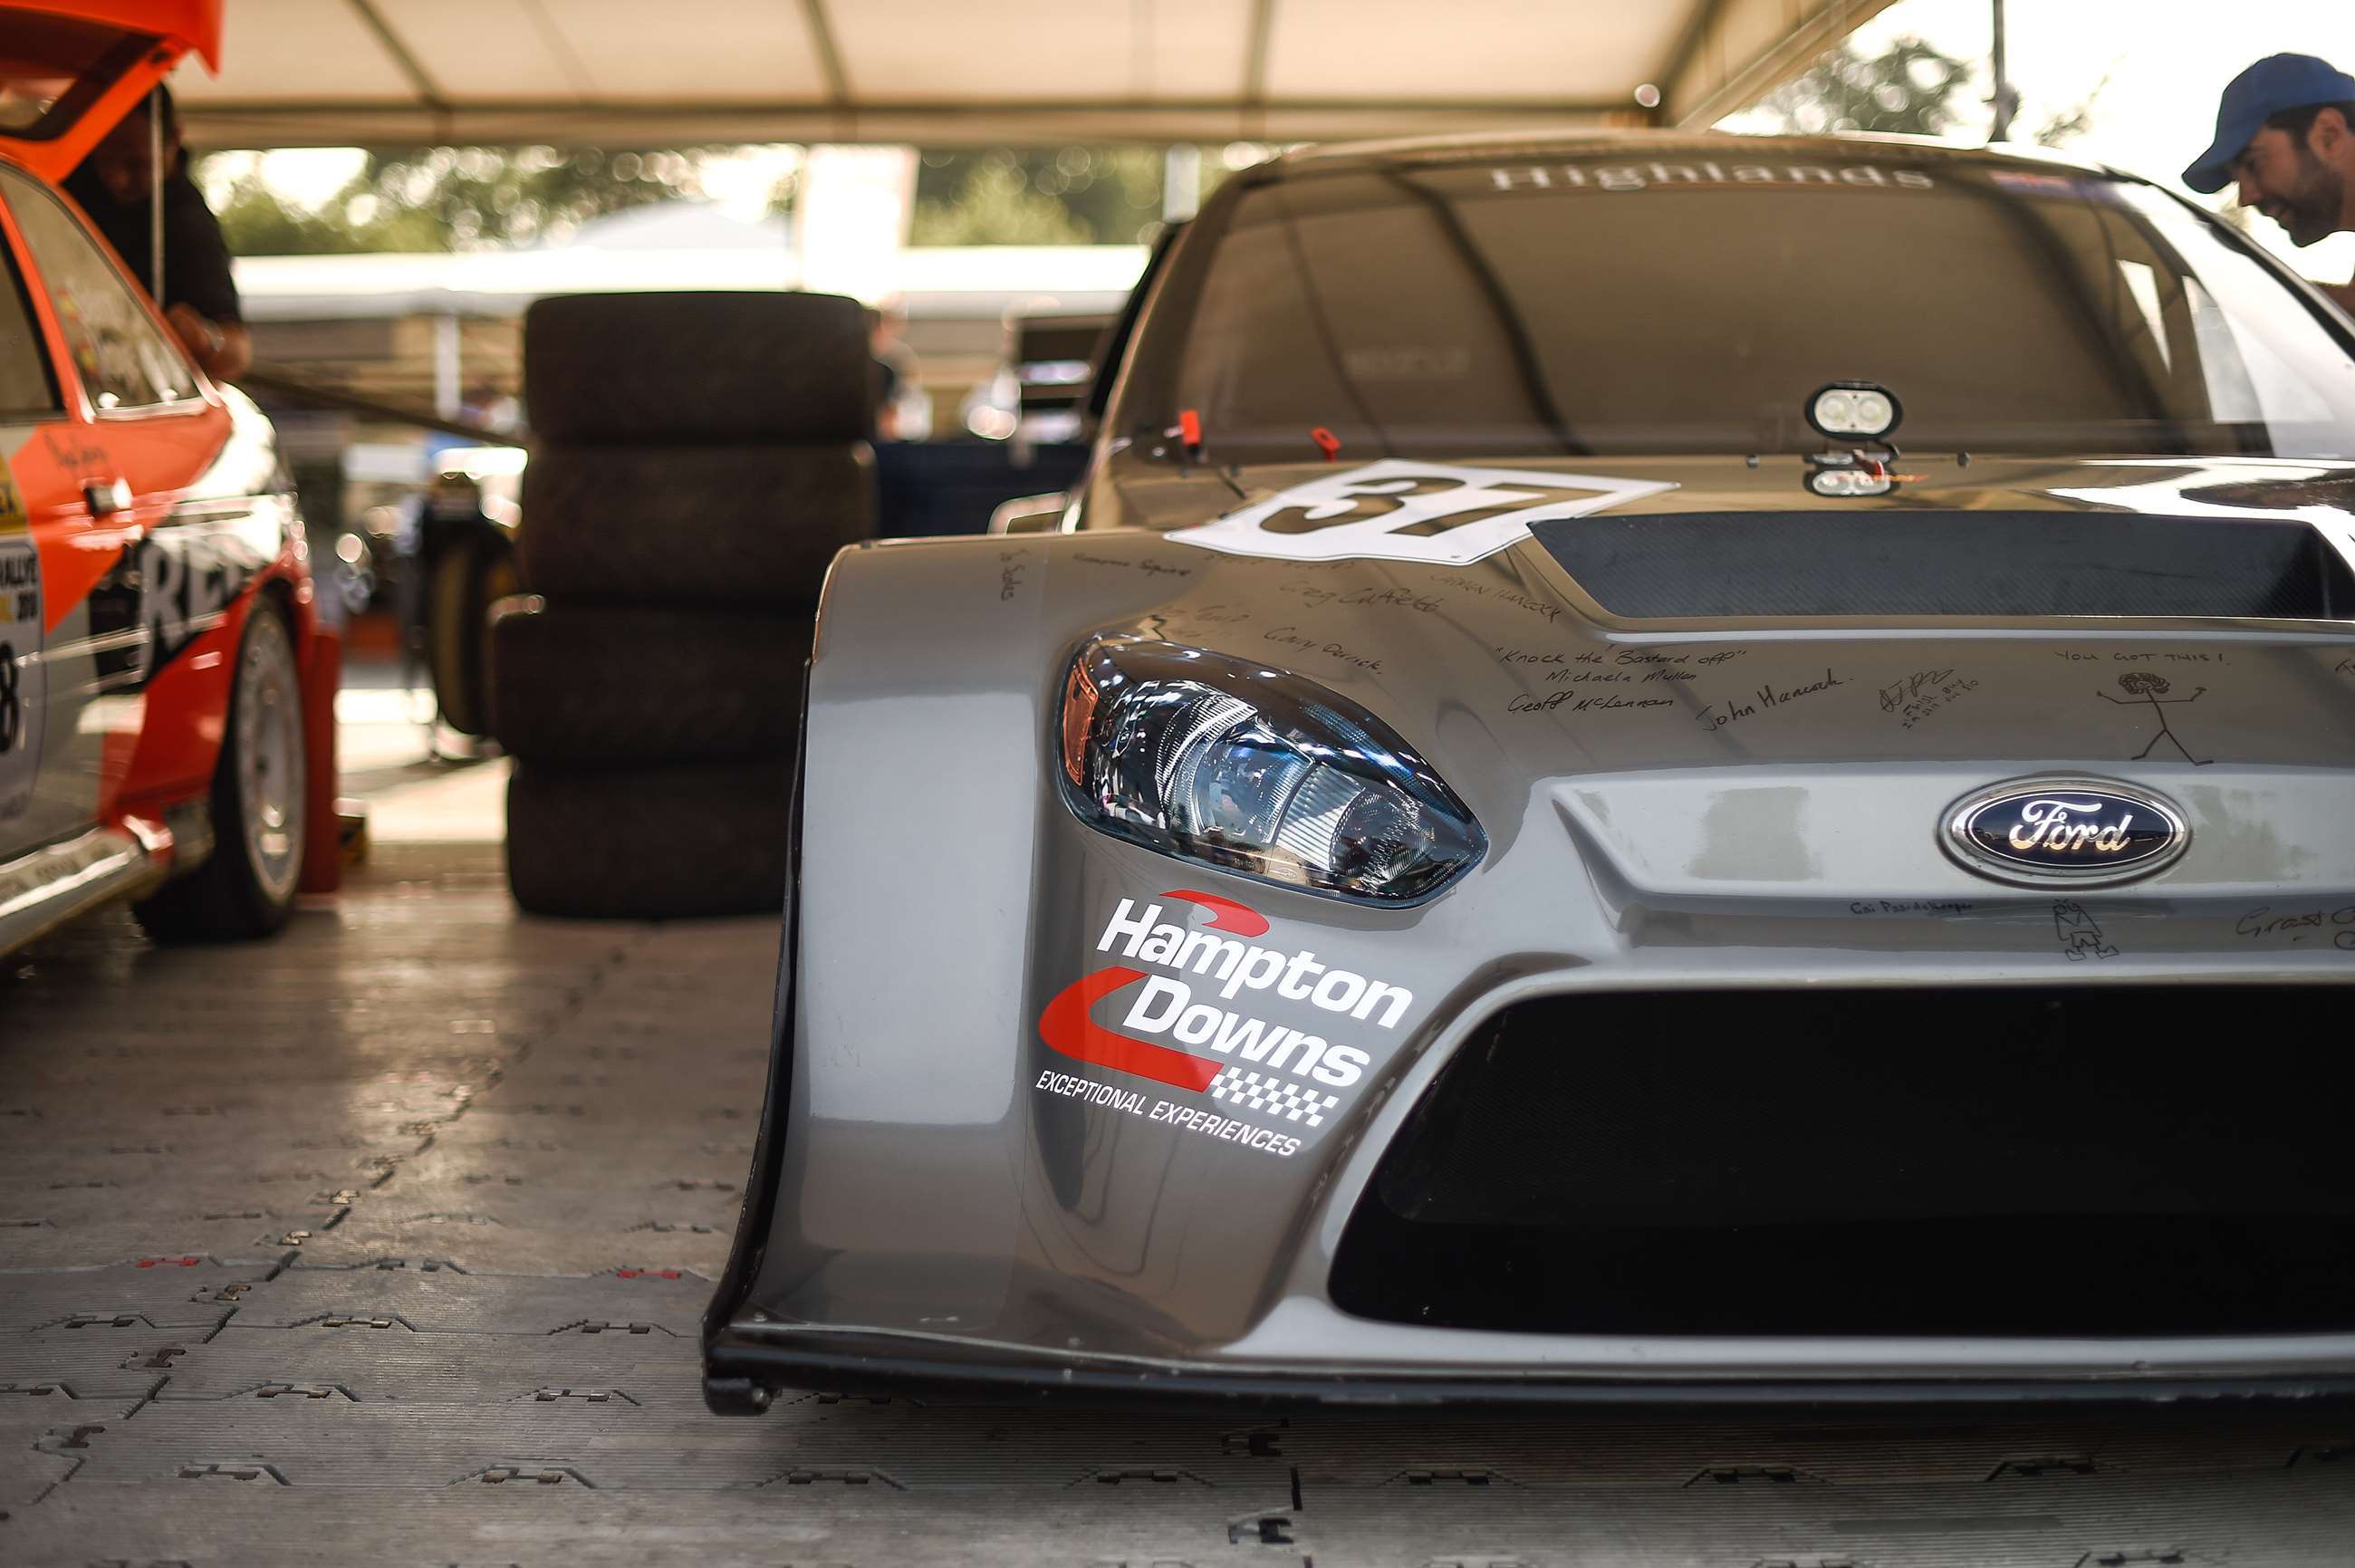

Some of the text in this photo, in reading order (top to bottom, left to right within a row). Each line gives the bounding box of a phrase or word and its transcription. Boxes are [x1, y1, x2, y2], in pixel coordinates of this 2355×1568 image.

[1492, 162, 1934, 191] Highlands
[1259, 476, 1617, 536] 37
[1575, 650, 1603, 664] the
[2113, 651, 2156, 661] GOT
[1696, 700, 1755, 731] John
[2009, 800, 2133, 851] Ford
[1096, 898, 1413, 1029] Hampton
[1122, 974, 1370, 1087] Downs
[1035, 1070, 1302, 1156] EXCEPTIONAL EXPERIENCES
